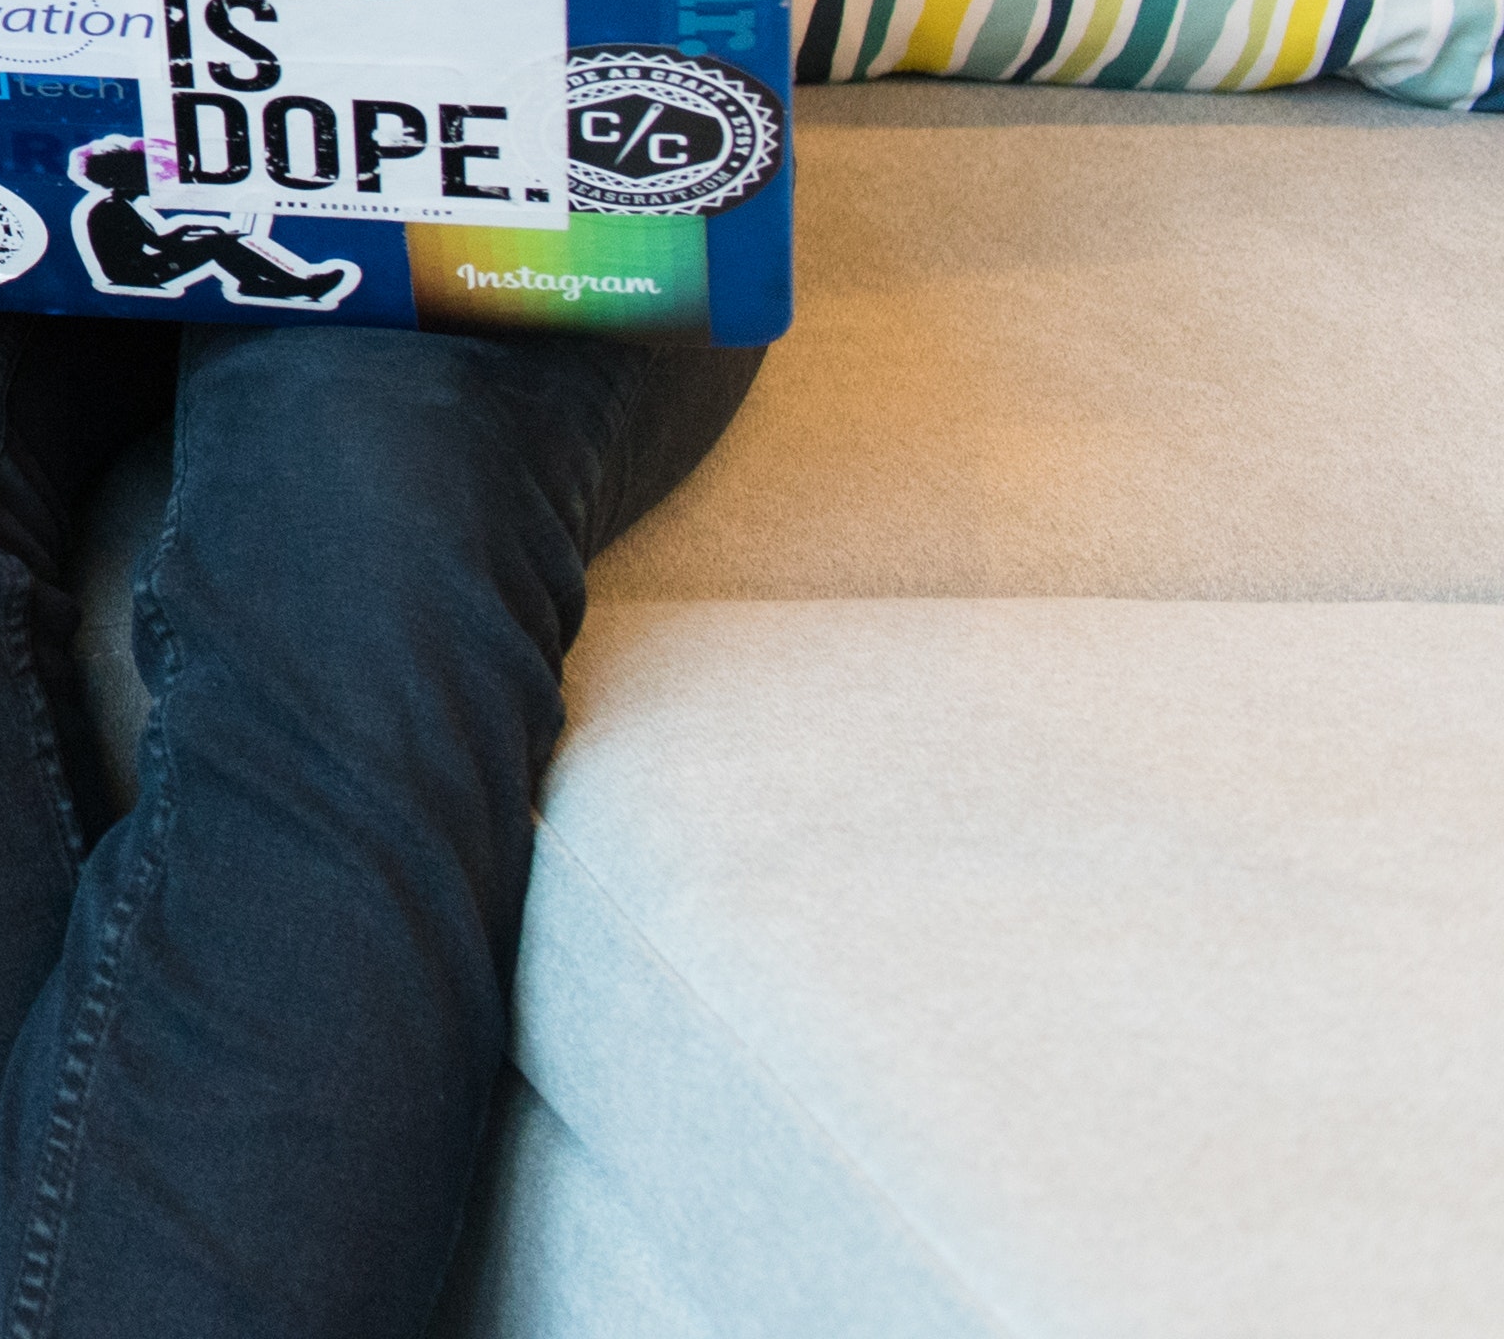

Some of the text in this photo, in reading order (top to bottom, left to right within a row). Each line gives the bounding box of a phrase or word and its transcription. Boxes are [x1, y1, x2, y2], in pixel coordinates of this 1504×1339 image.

[608, 68, 641, 79] AS
[650, 69, 728, 104] CRAFT
[172, 92, 550, 202] DOPE.
[731, 115, 753, 157] ETSY
[456, 263, 662, 301] Instagram
